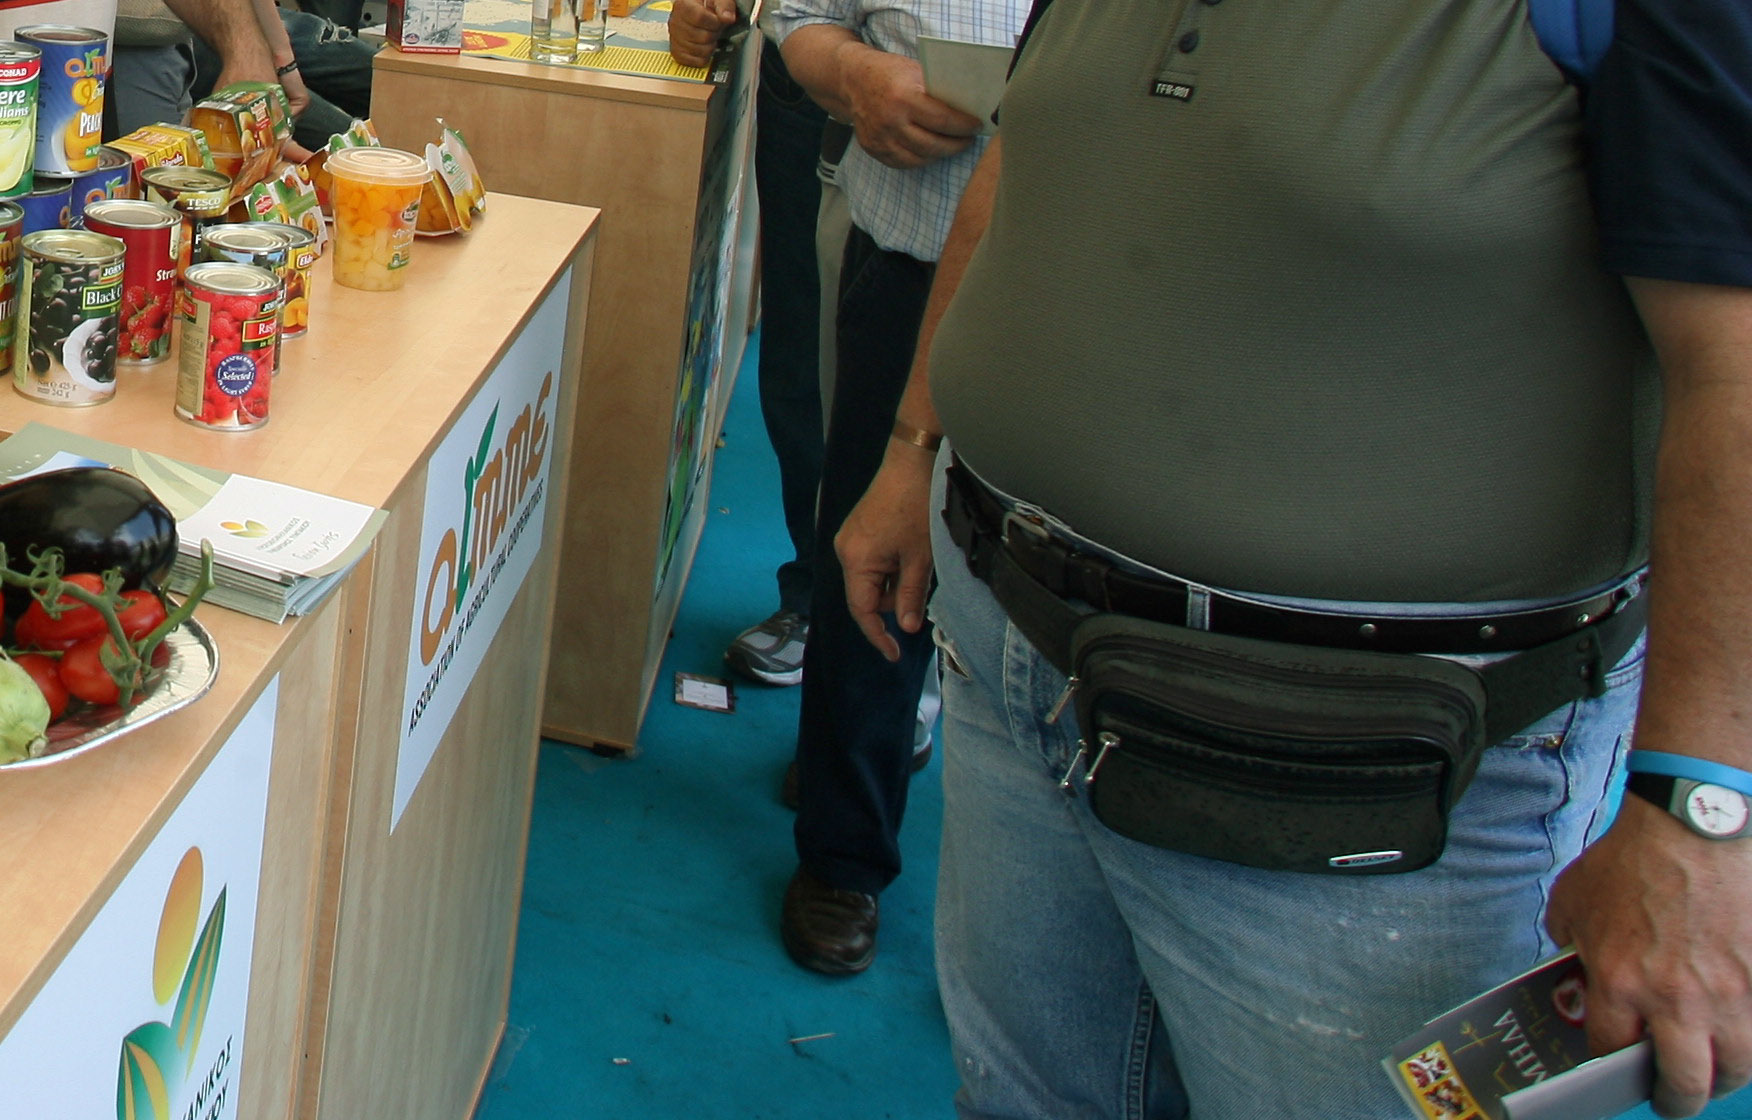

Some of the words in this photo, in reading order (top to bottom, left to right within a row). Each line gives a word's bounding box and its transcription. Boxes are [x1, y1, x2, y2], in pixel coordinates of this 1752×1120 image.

[187, 197, 221, 207] TESCO
[86, 289, 116, 306] Black
[222, 371, 252, 381] Selected
[408, 635, 456, 737] ASSOCIATION
[464, 545, 508, 635] AGRICULTURAL
[507, 477, 544, 557] COOPERATIVES
